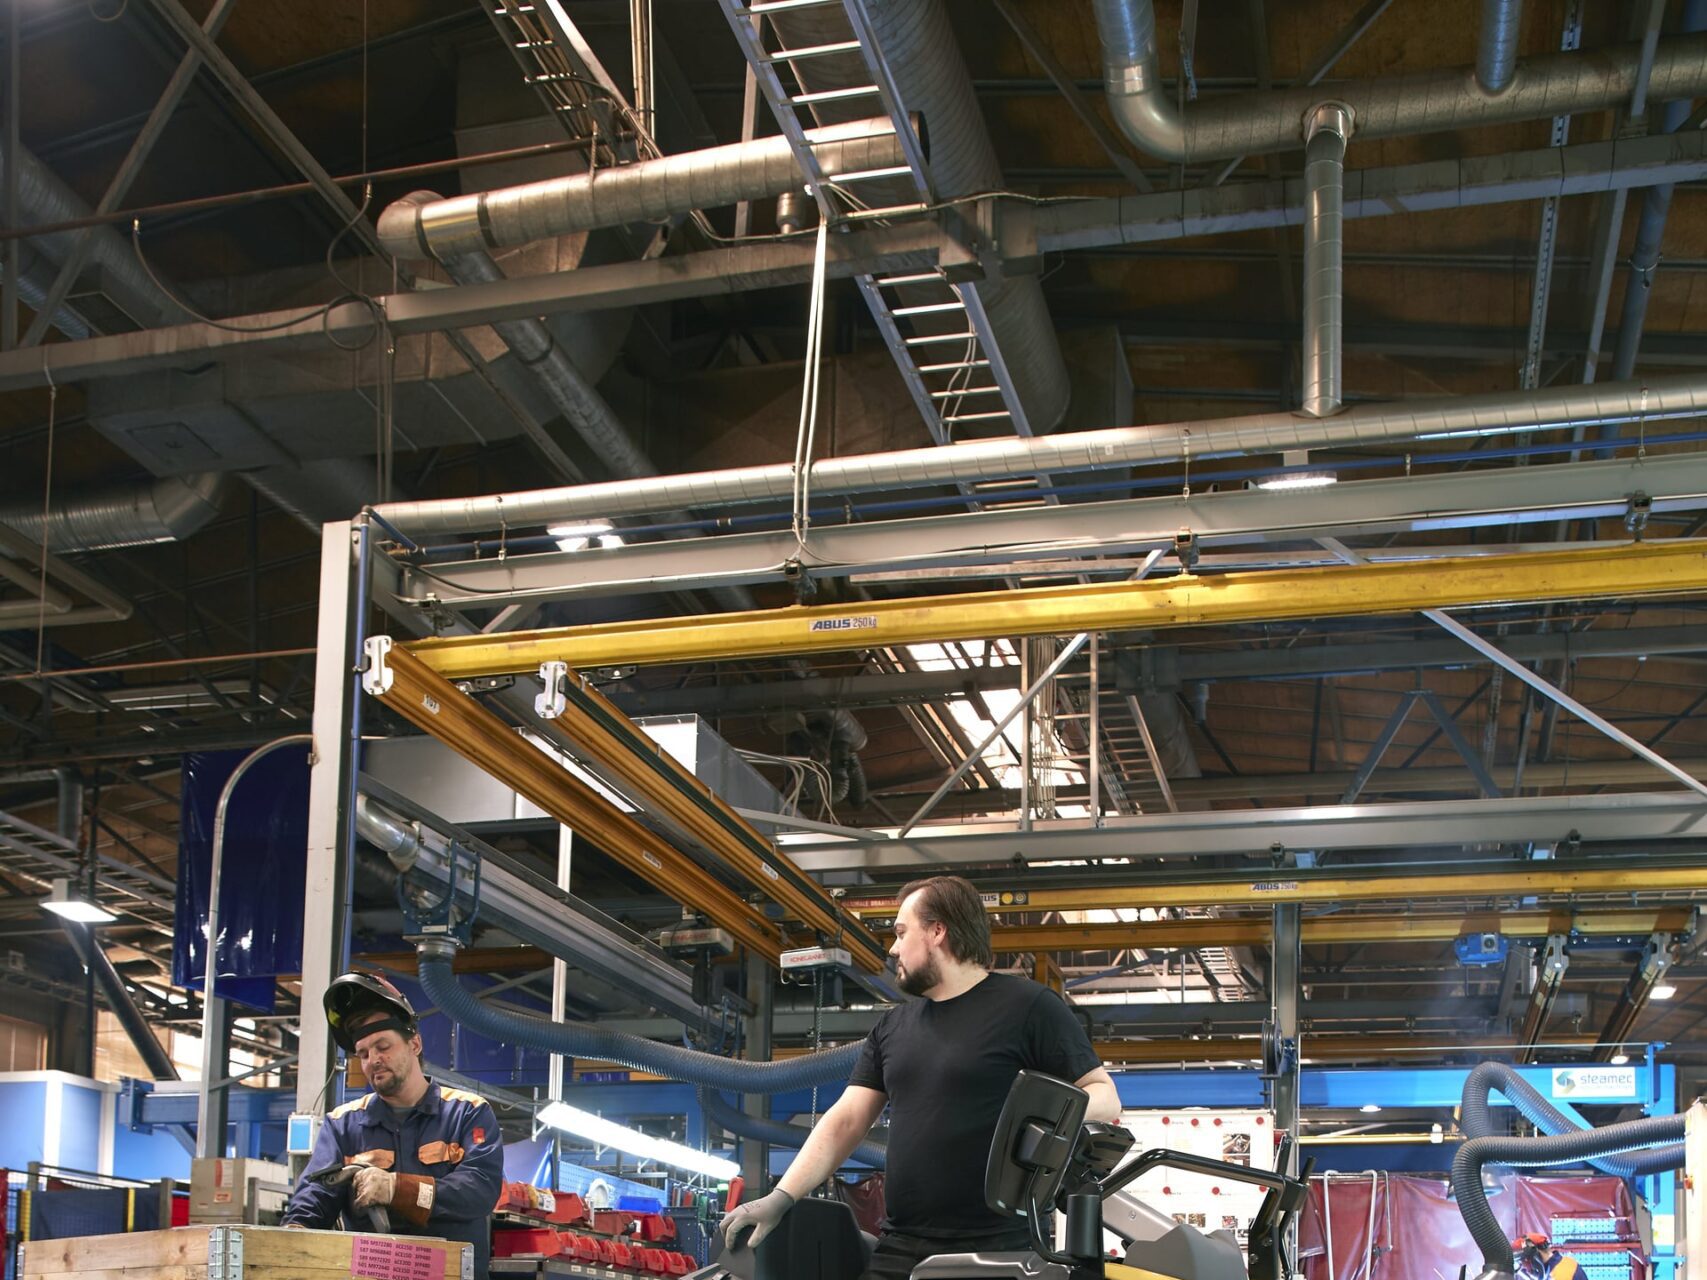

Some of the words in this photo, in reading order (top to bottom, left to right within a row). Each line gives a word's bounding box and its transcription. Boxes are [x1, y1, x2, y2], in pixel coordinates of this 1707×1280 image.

[813, 619, 851, 630] ABUS
[853, 617, 868, 628] 250
[1252, 883, 1279, 891] ABUS
[1580, 1073, 1633, 1085] steamec
